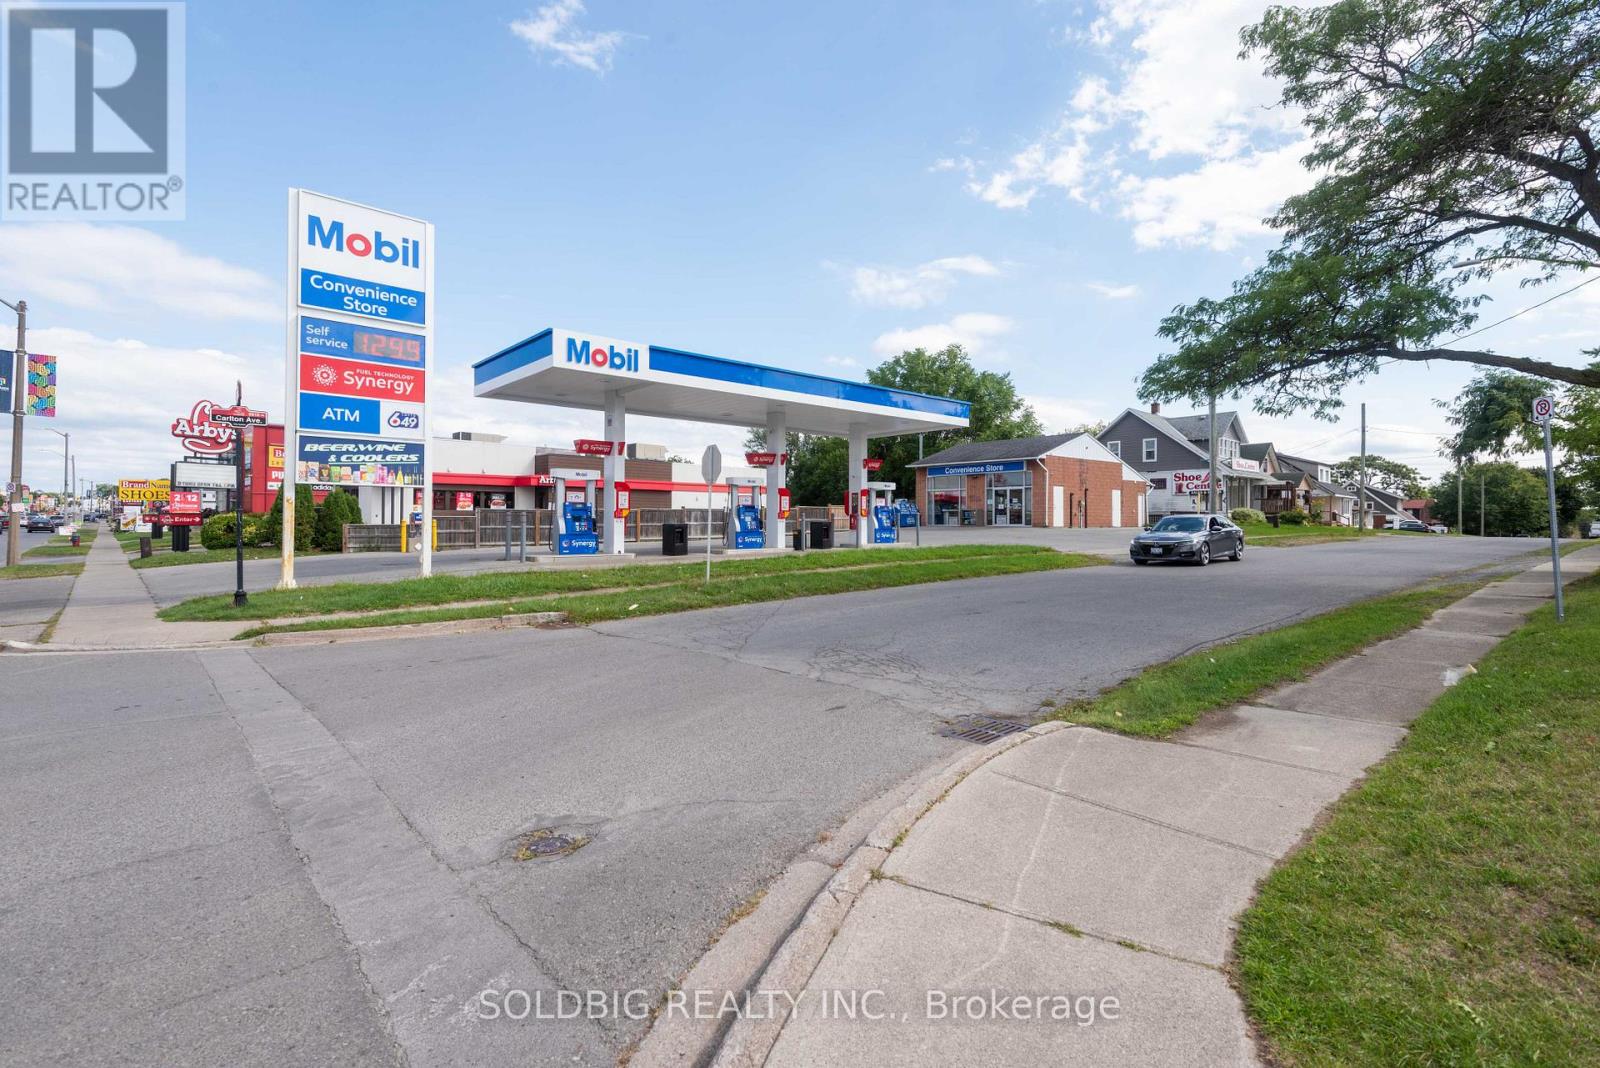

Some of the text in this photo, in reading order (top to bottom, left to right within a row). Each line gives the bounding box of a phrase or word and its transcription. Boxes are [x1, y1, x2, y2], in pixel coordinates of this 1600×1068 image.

[307, 214, 420, 269] Mobil
[309, 275, 417, 306] Convenience
[343, 297, 388, 316] Store
[306, 324, 330, 336] Self
[306, 335, 348, 349] service
[567, 337, 639, 373] Mobil
[373, 370, 416, 380] TECHNOLOGY
[343, 371, 415, 396] Synergy
[215, 414, 244, 422] Carlton
[322, 407, 360, 422] ATM
[328, 454, 419, 462] & COOLERS
[945, 464, 1004, 474] Convenience Store
[1174, 472, 1202, 482] Shoe
[122, 480, 150, 488] Brand
[571, 540, 597, 548] Synergy
